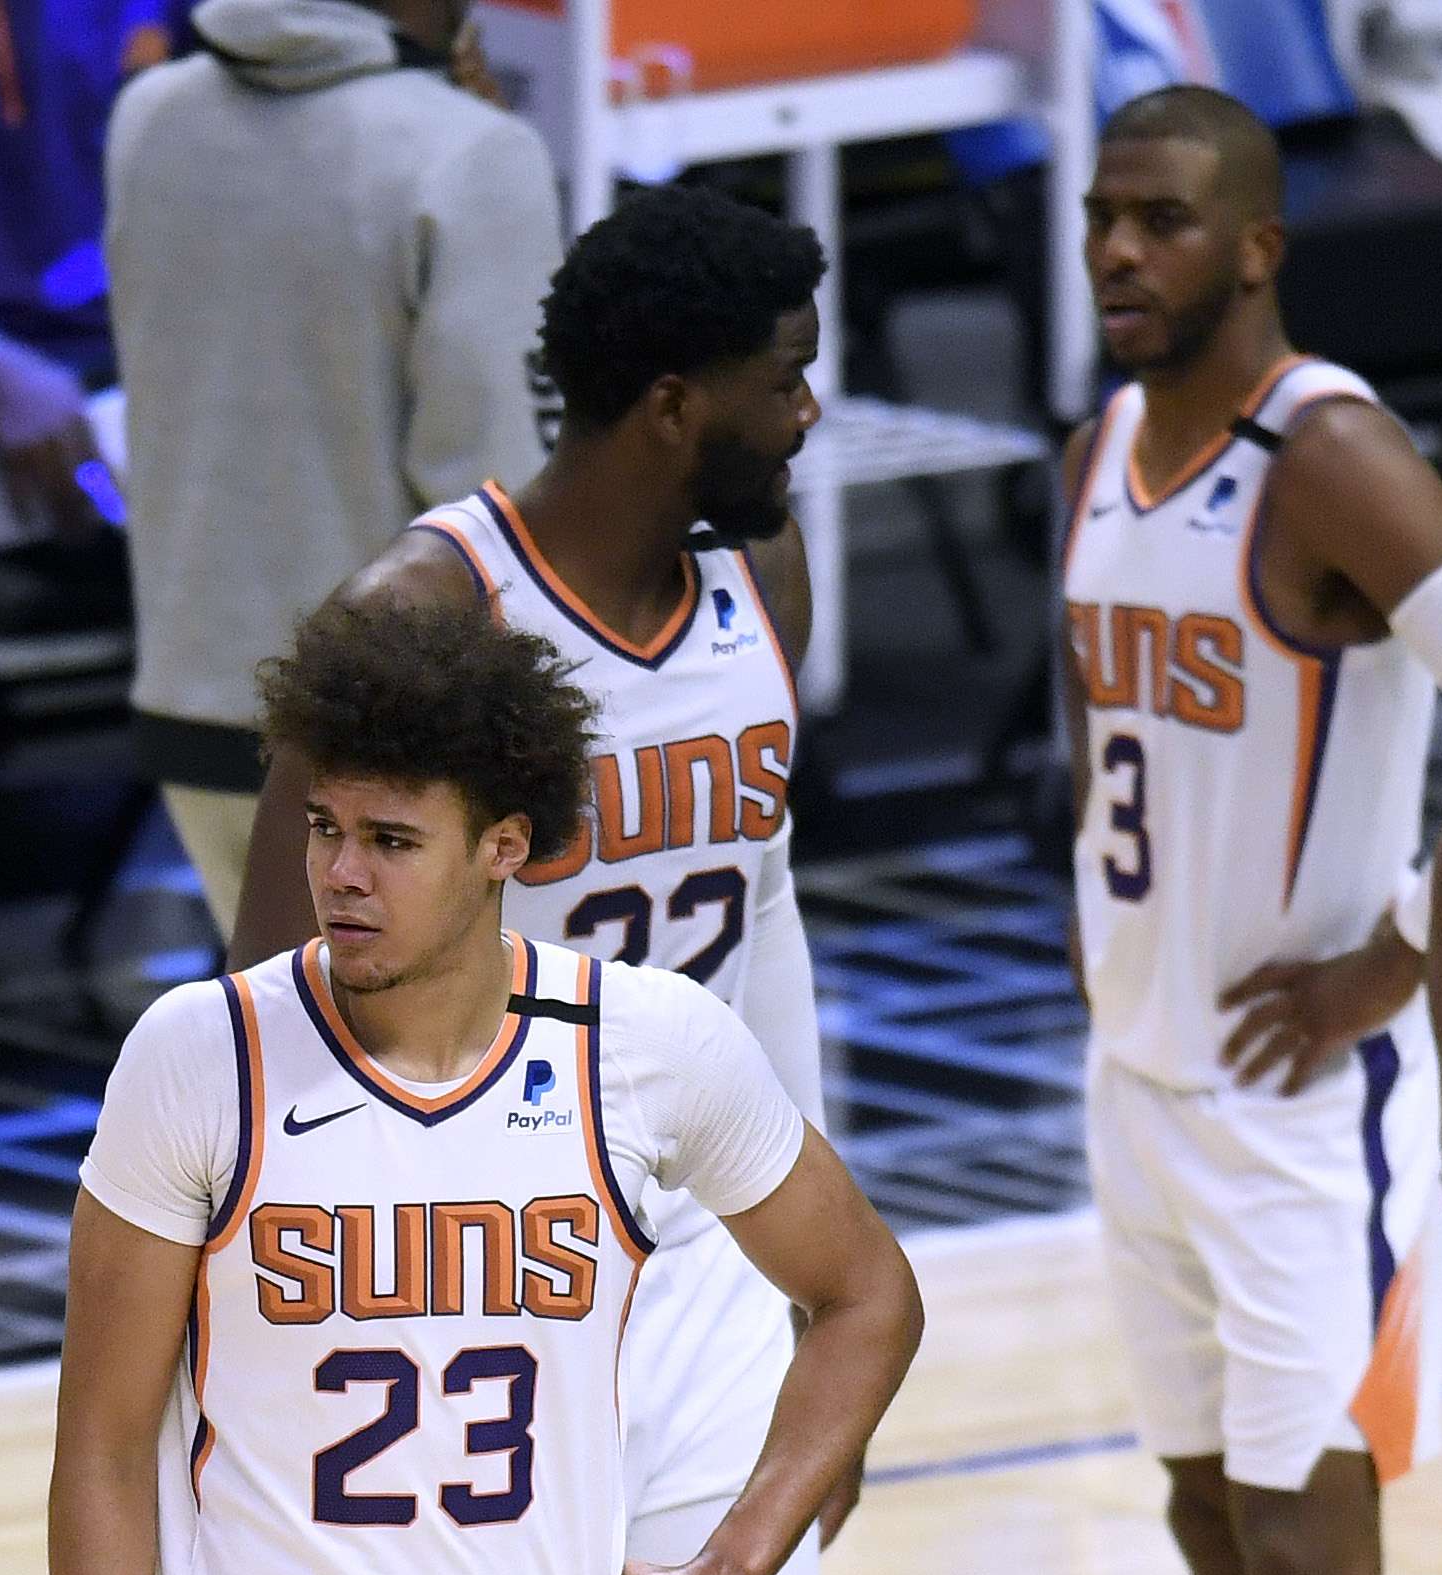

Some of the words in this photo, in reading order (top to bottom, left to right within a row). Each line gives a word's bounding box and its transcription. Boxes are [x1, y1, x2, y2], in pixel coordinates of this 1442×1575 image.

[512, 720, 790, 886] UNS
[1102, 734, 1151, 902] 3
[507, 1109, 573, 1132] PayPal
[249, 1194, 600, 1325] SUNS
[313, 1344, 539, 1529] 23
